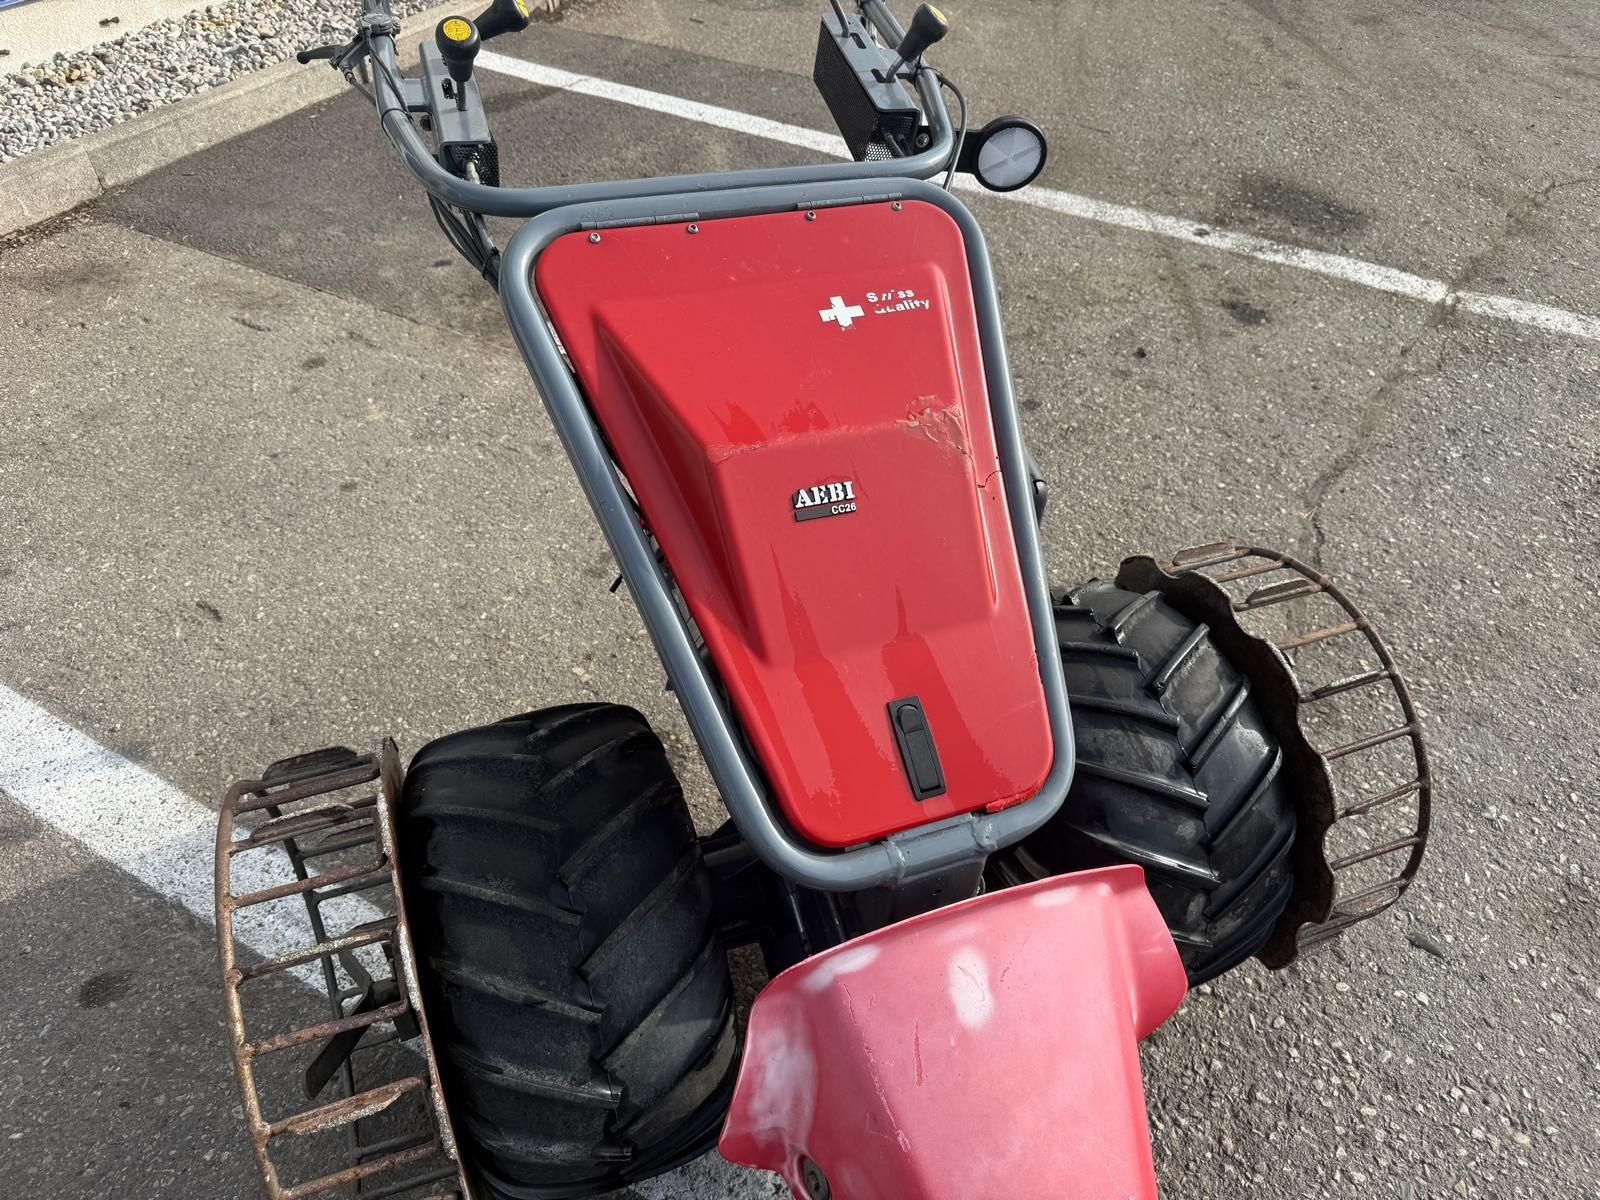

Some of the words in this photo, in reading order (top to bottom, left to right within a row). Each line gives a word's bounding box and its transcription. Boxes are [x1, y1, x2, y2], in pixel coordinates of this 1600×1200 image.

[866, 289, 915, 302] Sss
[795, 481, 855, 508] AEBI
[831, 502, 857, 515] CC26
